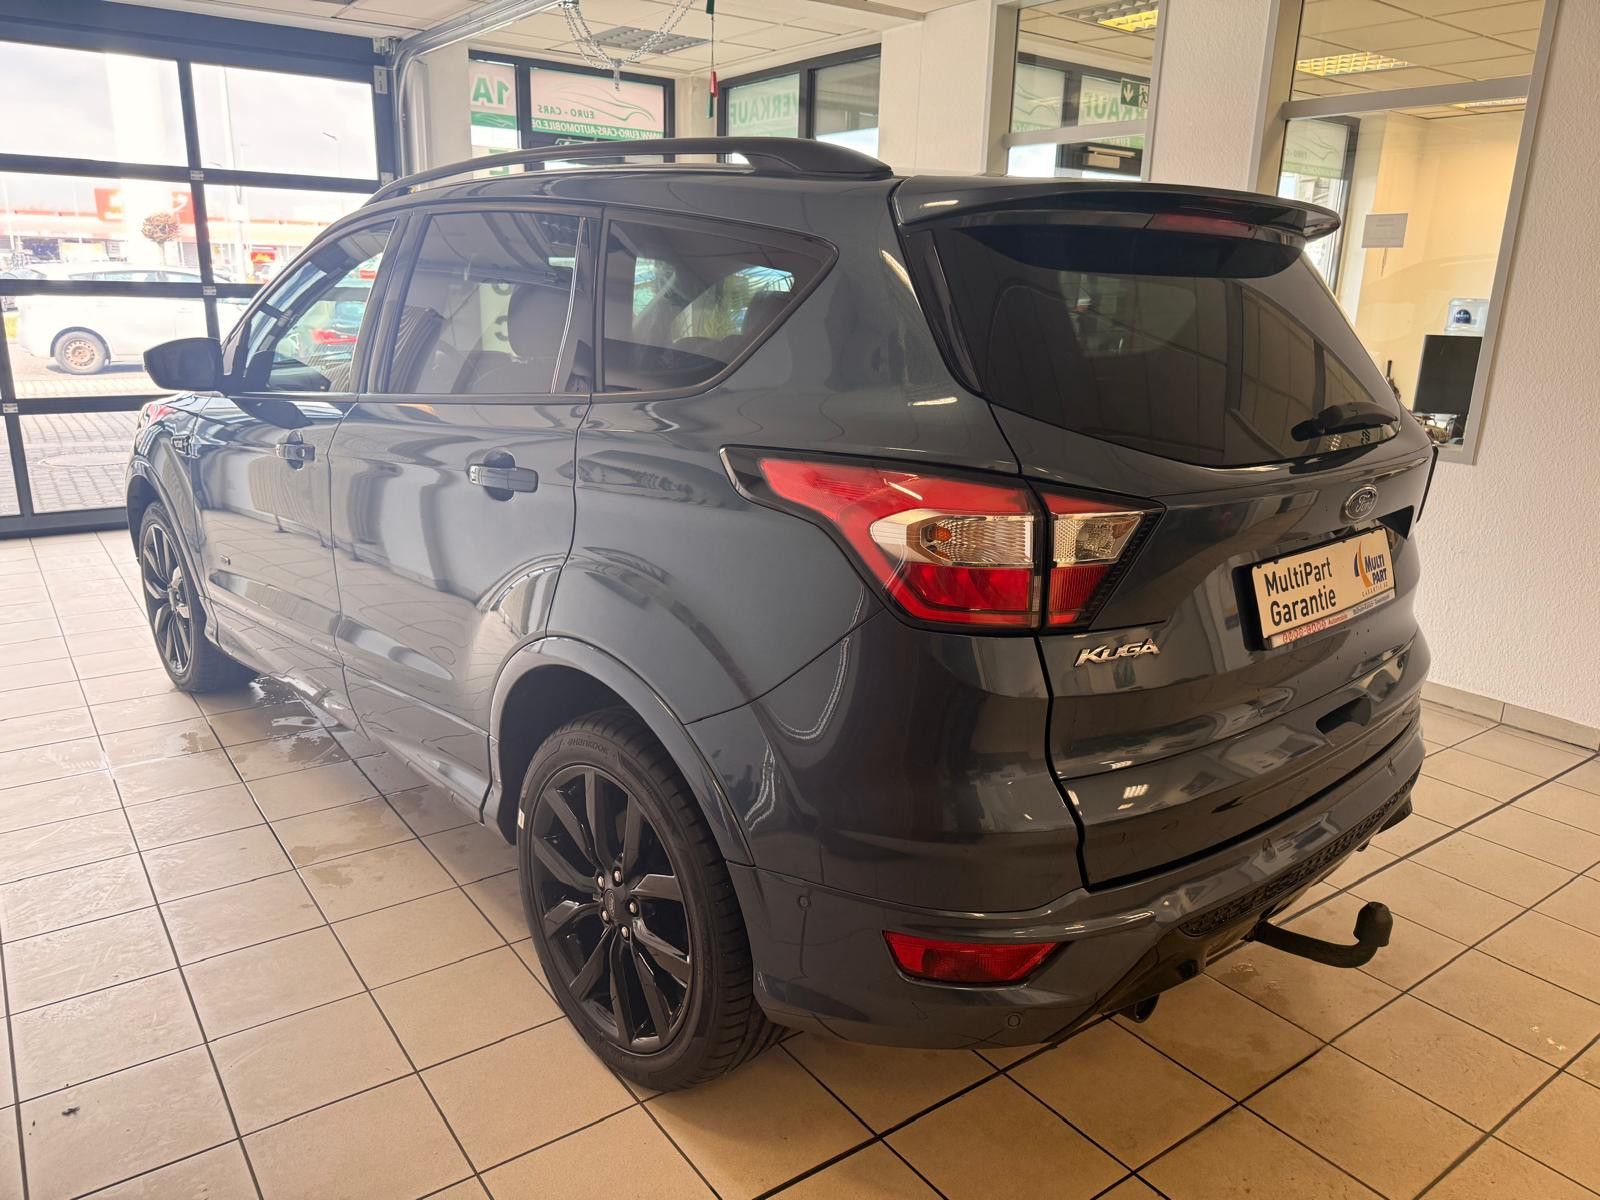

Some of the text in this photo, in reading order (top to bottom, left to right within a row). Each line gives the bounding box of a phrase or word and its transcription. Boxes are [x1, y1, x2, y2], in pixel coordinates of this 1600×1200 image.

[1264, 557, 1333, 597] MultiPart
[1364, 553, 1385, 574] MULTI
[1371, 567, 1387, 585] PART
[1270, 586, 1337, 627] Garantie
[1074, 638, 1160, 667] KUGA
